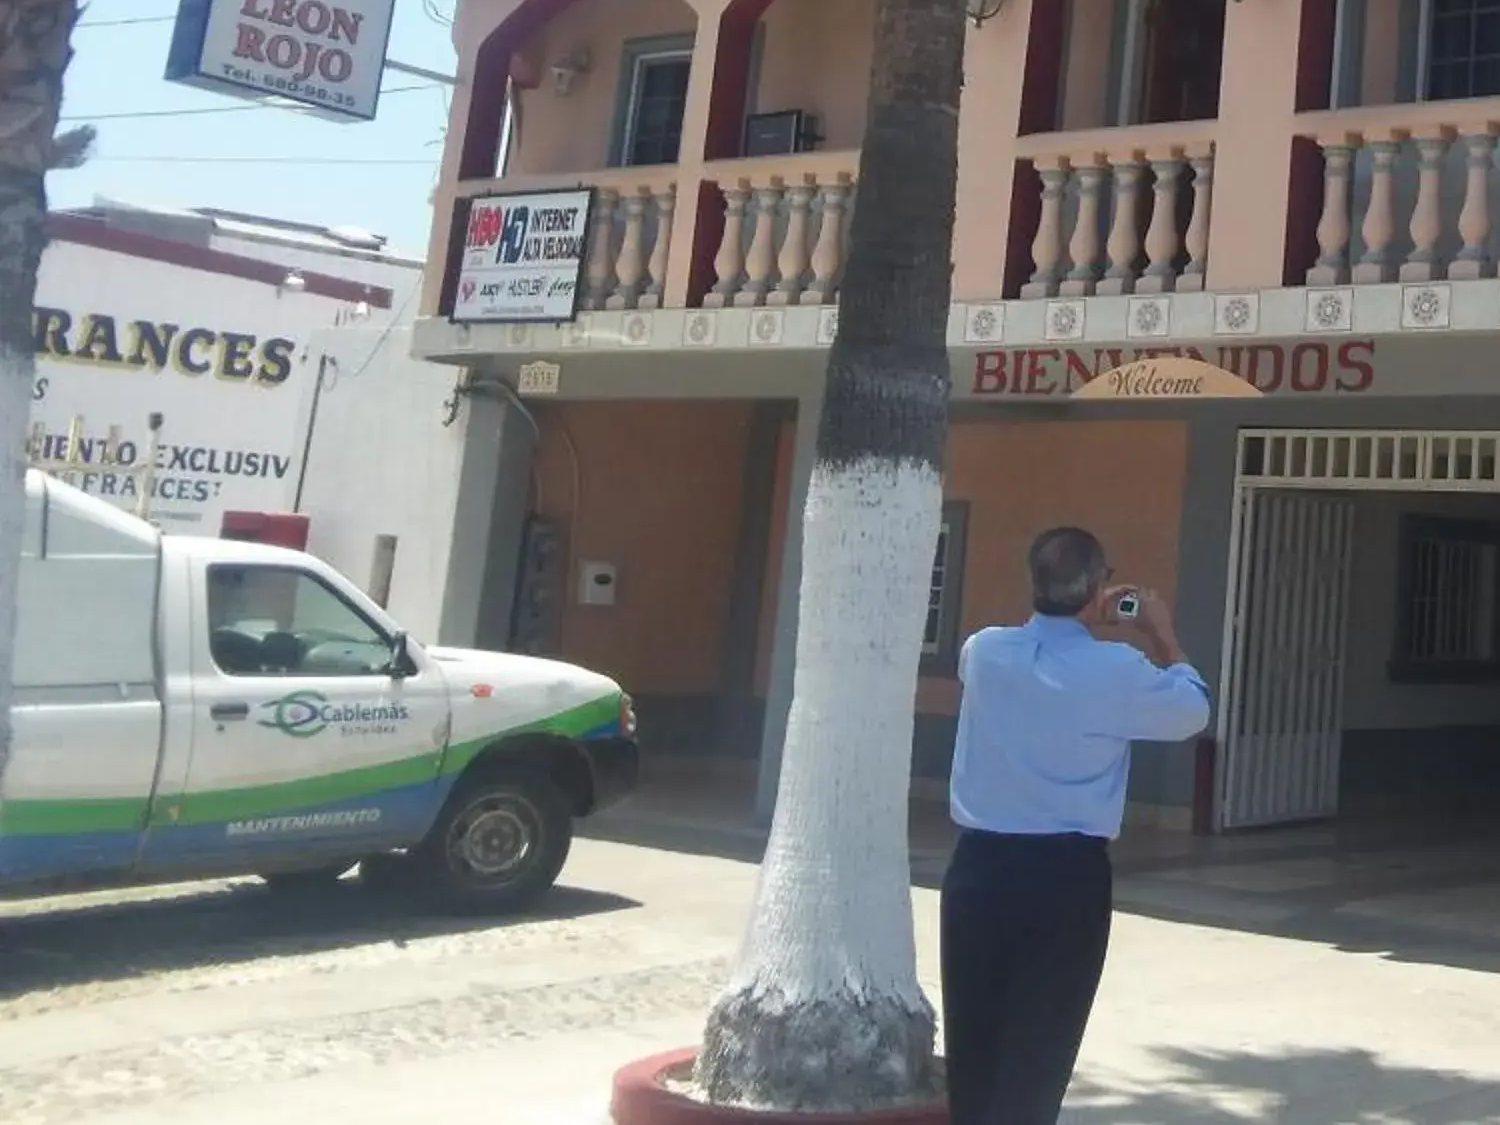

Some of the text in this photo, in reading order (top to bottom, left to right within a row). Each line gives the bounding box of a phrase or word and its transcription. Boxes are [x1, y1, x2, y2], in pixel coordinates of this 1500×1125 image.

[231, 22, 354, 84] ROJO
[530, 207, 578, 233] INTERNET
[1108, 362, 1206, 396] Welcome
[226, 807, 381, 838] MANTENIMIENTO
